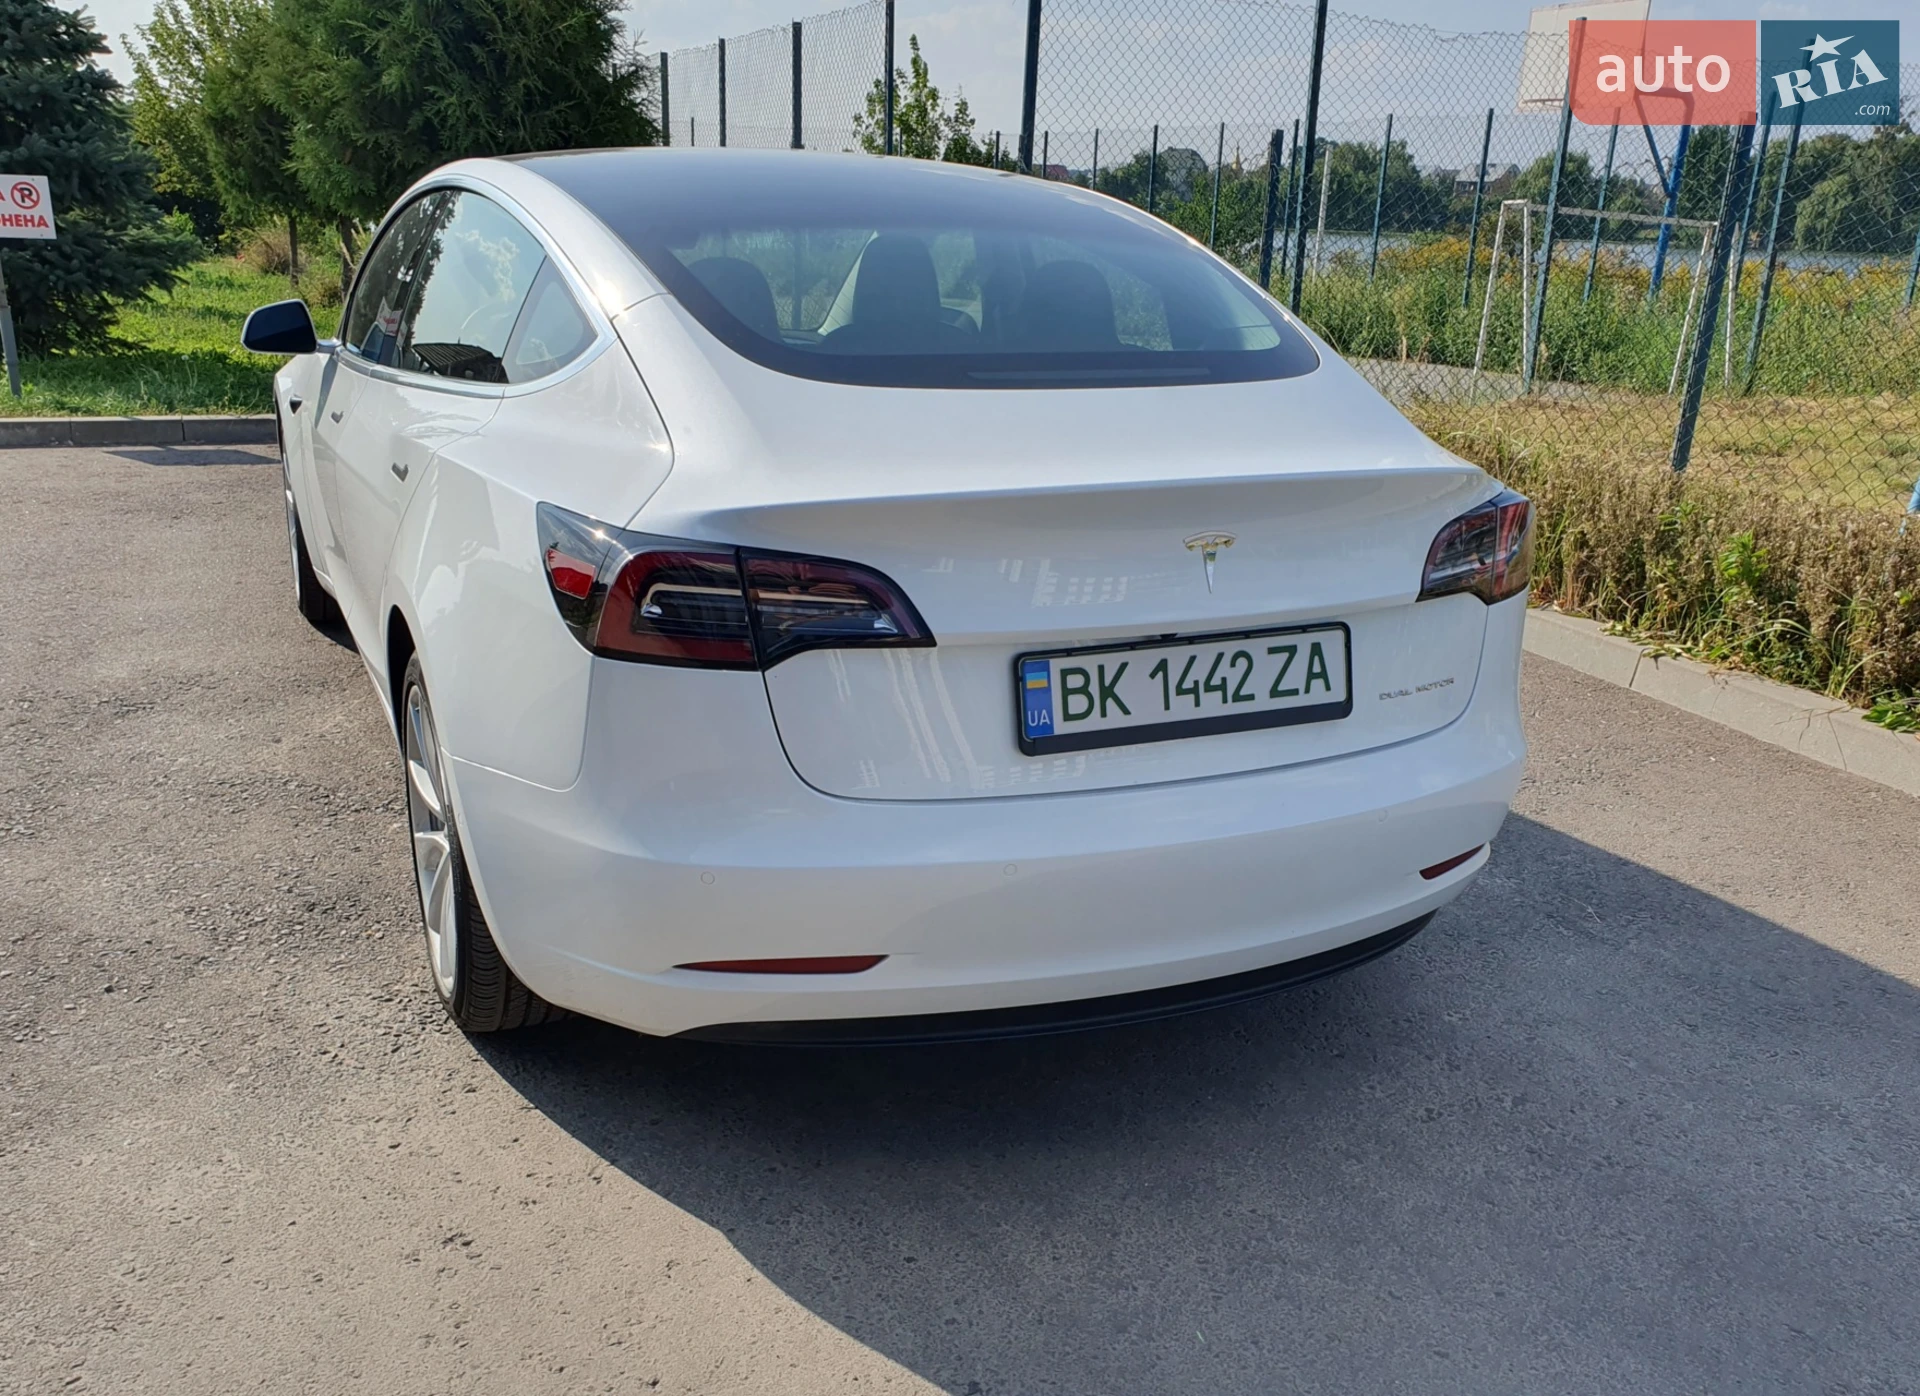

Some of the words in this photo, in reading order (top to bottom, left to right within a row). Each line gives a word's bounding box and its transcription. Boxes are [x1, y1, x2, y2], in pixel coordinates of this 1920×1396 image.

[0, 213, 50, 229] НЕНА
[1060, 661, 1132, 722] BK
[1149, 651, 1256, 711] 1442
[1267, 642, 1332, 699] ZA
[1379, 689, 1413, 701] DUAL
[1415, 677, 1455, 693] MOTOR
[1028, 709, 1051, 727] UA
